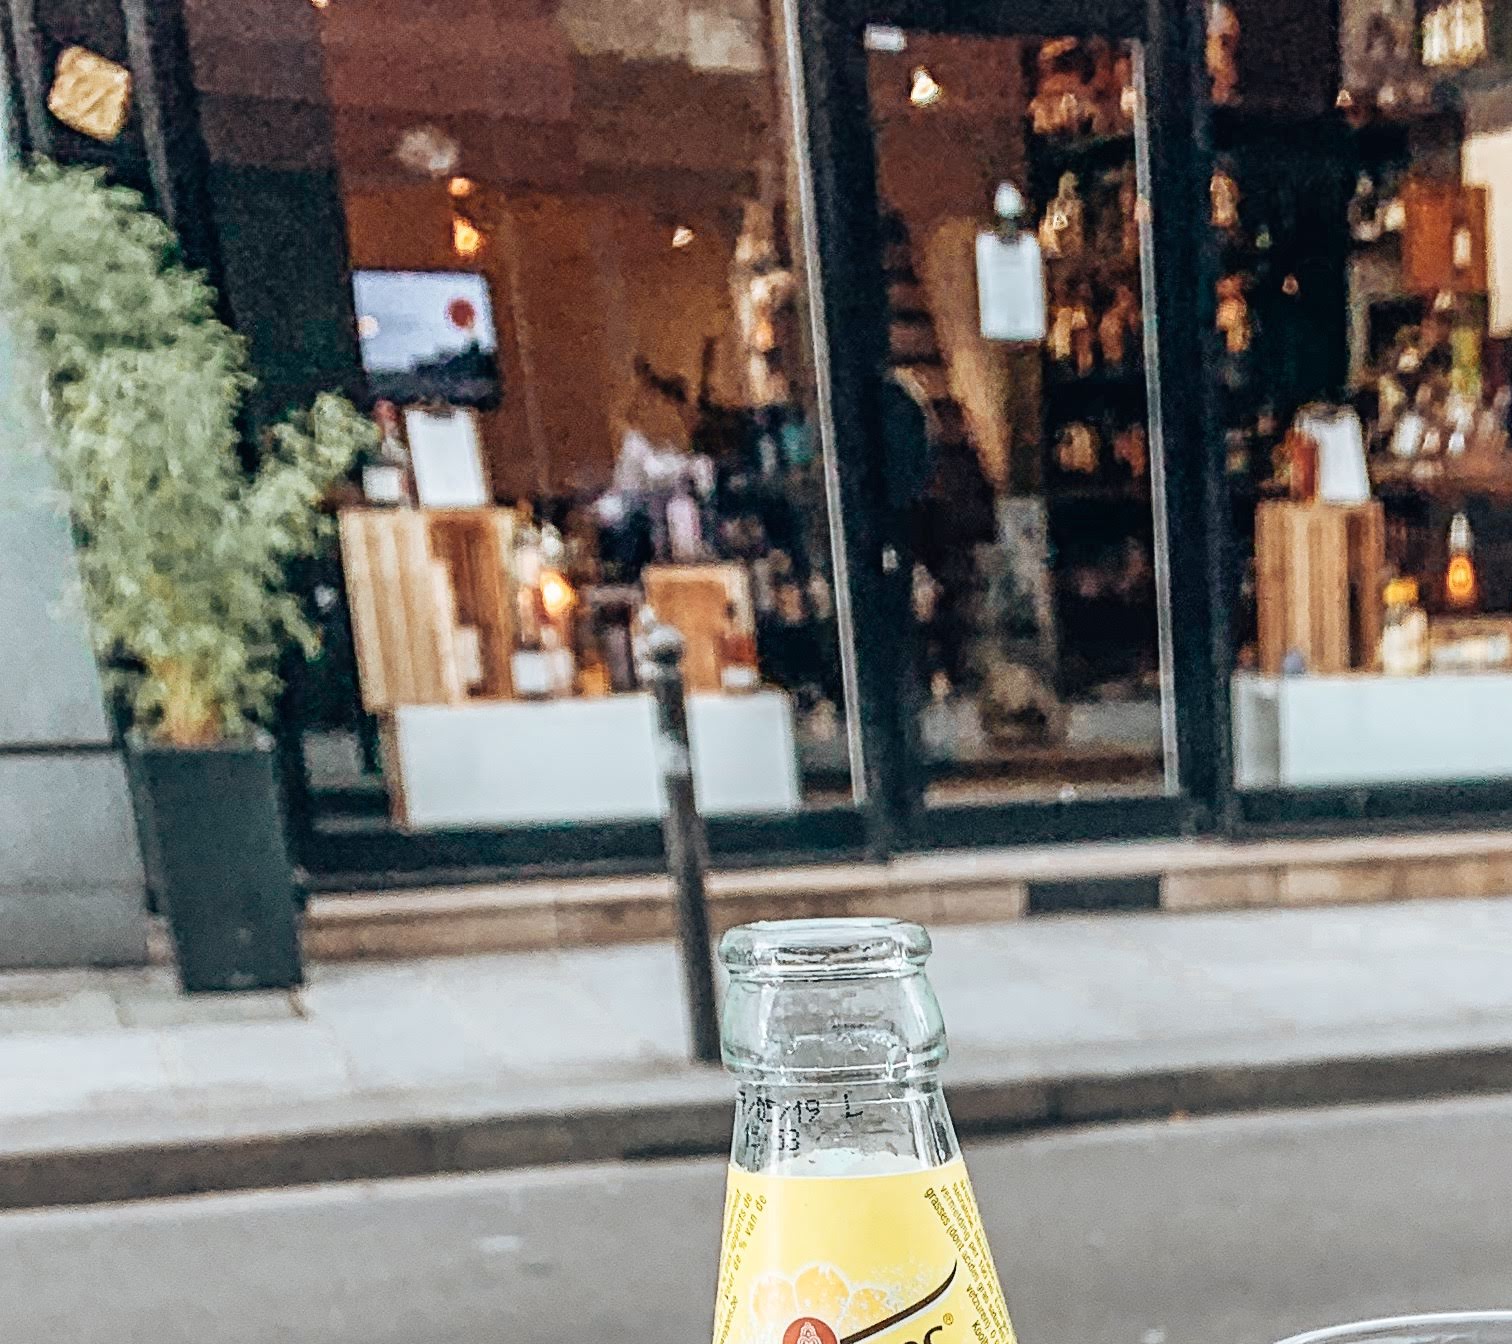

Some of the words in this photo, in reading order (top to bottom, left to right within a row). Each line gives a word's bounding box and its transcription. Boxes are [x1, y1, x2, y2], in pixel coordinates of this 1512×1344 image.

[755, 1195, 766, 1212] de
[926, 1188, 949, 1226] grasses
[947, 1225, 964, 1251] (dont
